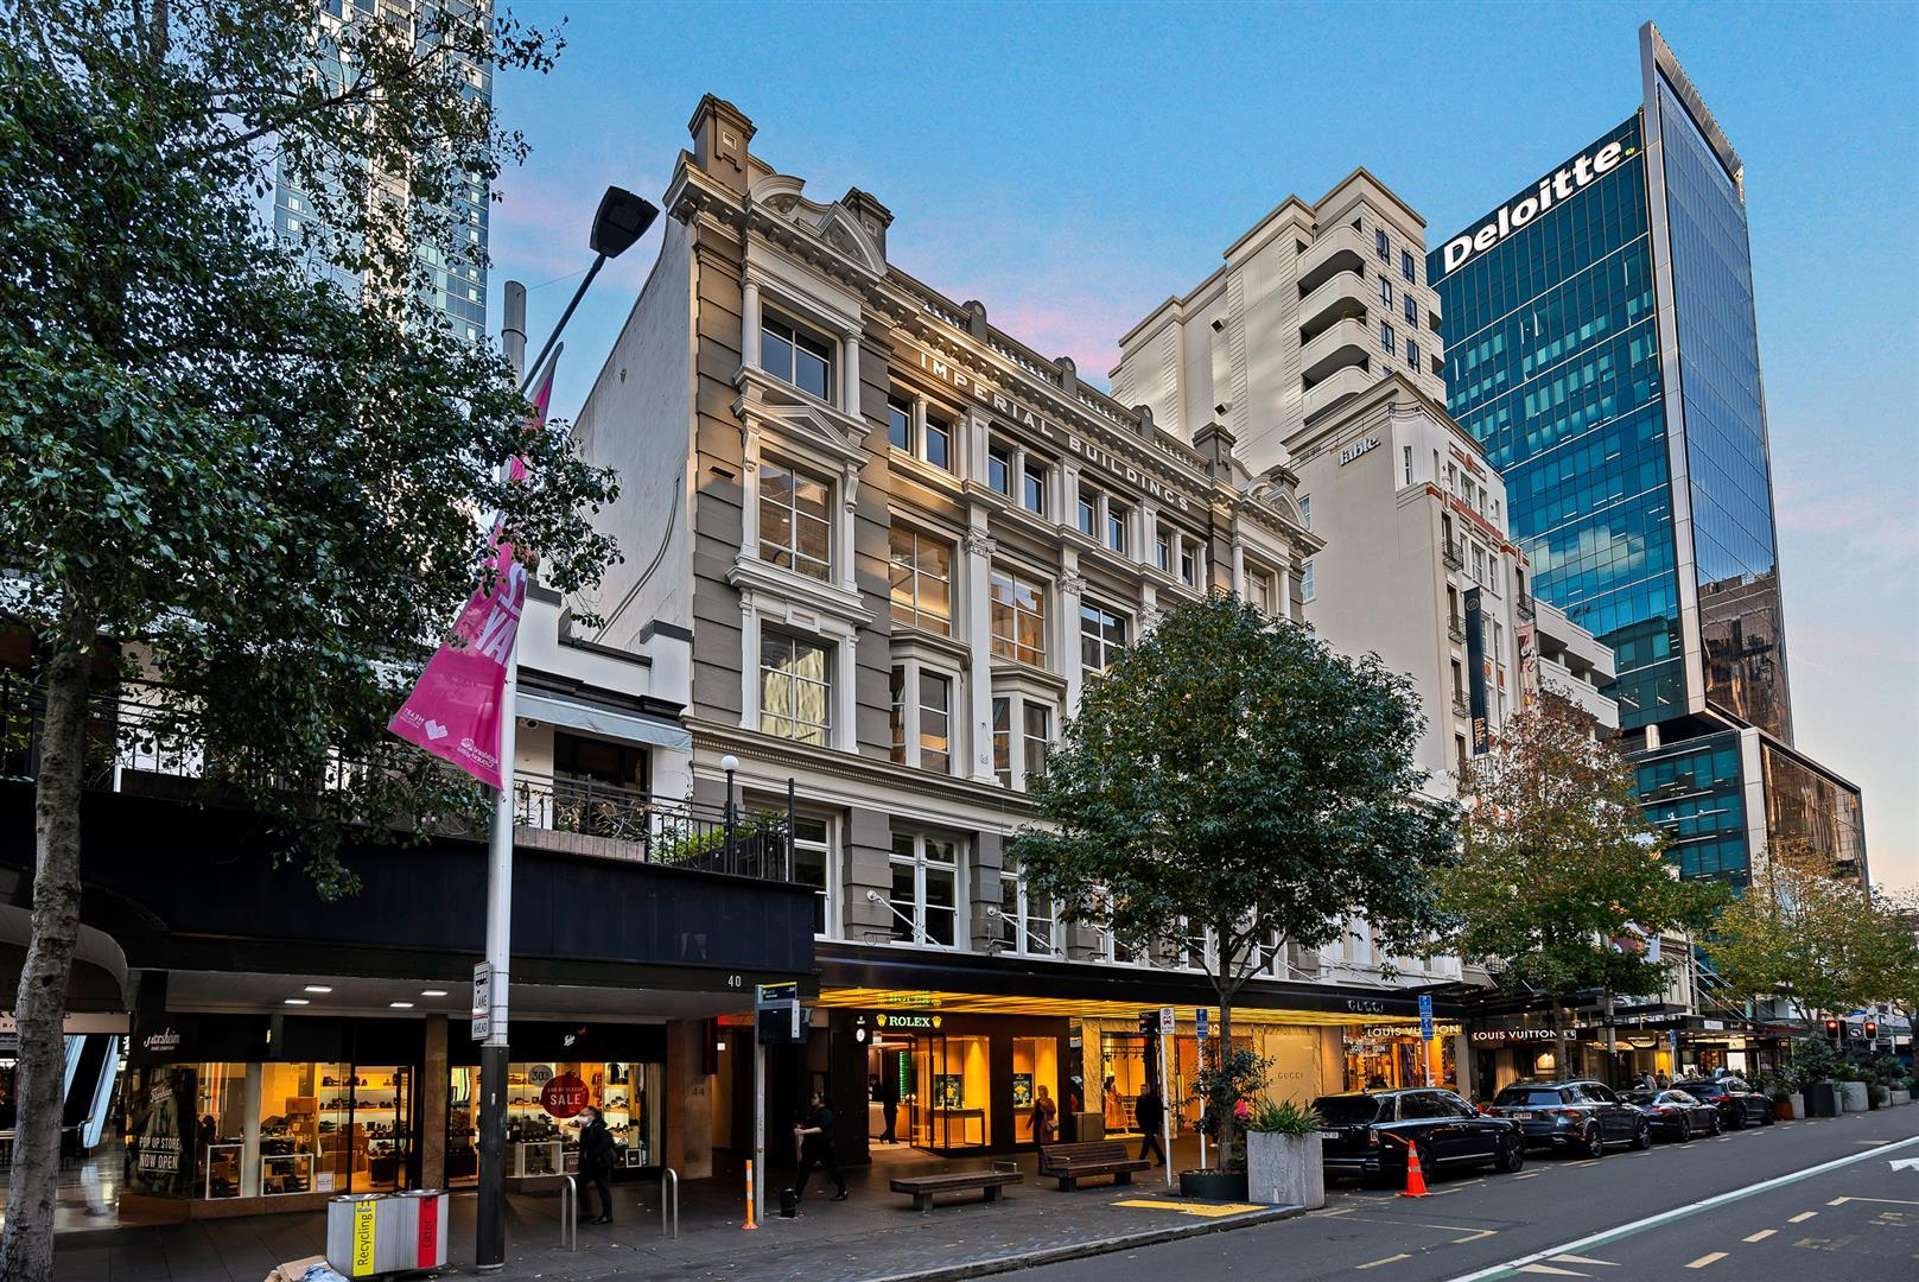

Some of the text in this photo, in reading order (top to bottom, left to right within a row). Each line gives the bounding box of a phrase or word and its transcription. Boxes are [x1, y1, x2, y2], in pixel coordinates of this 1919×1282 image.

[920, 352, 1189, 511] IMPERIAL BUILDINGS
[728, 975, 742, 988] 40
[1347, 1000, 1384, 1013] GUCCI
[889, 1016, 931, 1028] ROLEX
[1367, 1026, 1402, 1038] LOUIS
[1473, 1031, 1506, 1041] LOUIS
[1508, 1029, 1558, 1040] VUITTON
[550, 1094, 582, 1106] SALE
[139, 1136, 151, 1149] POP
[161, 1137, 181, 1150] STORE
[139, 1153, 178, 1170] NOW OPEN
[357, 1213, 373, 1267] Recycling
